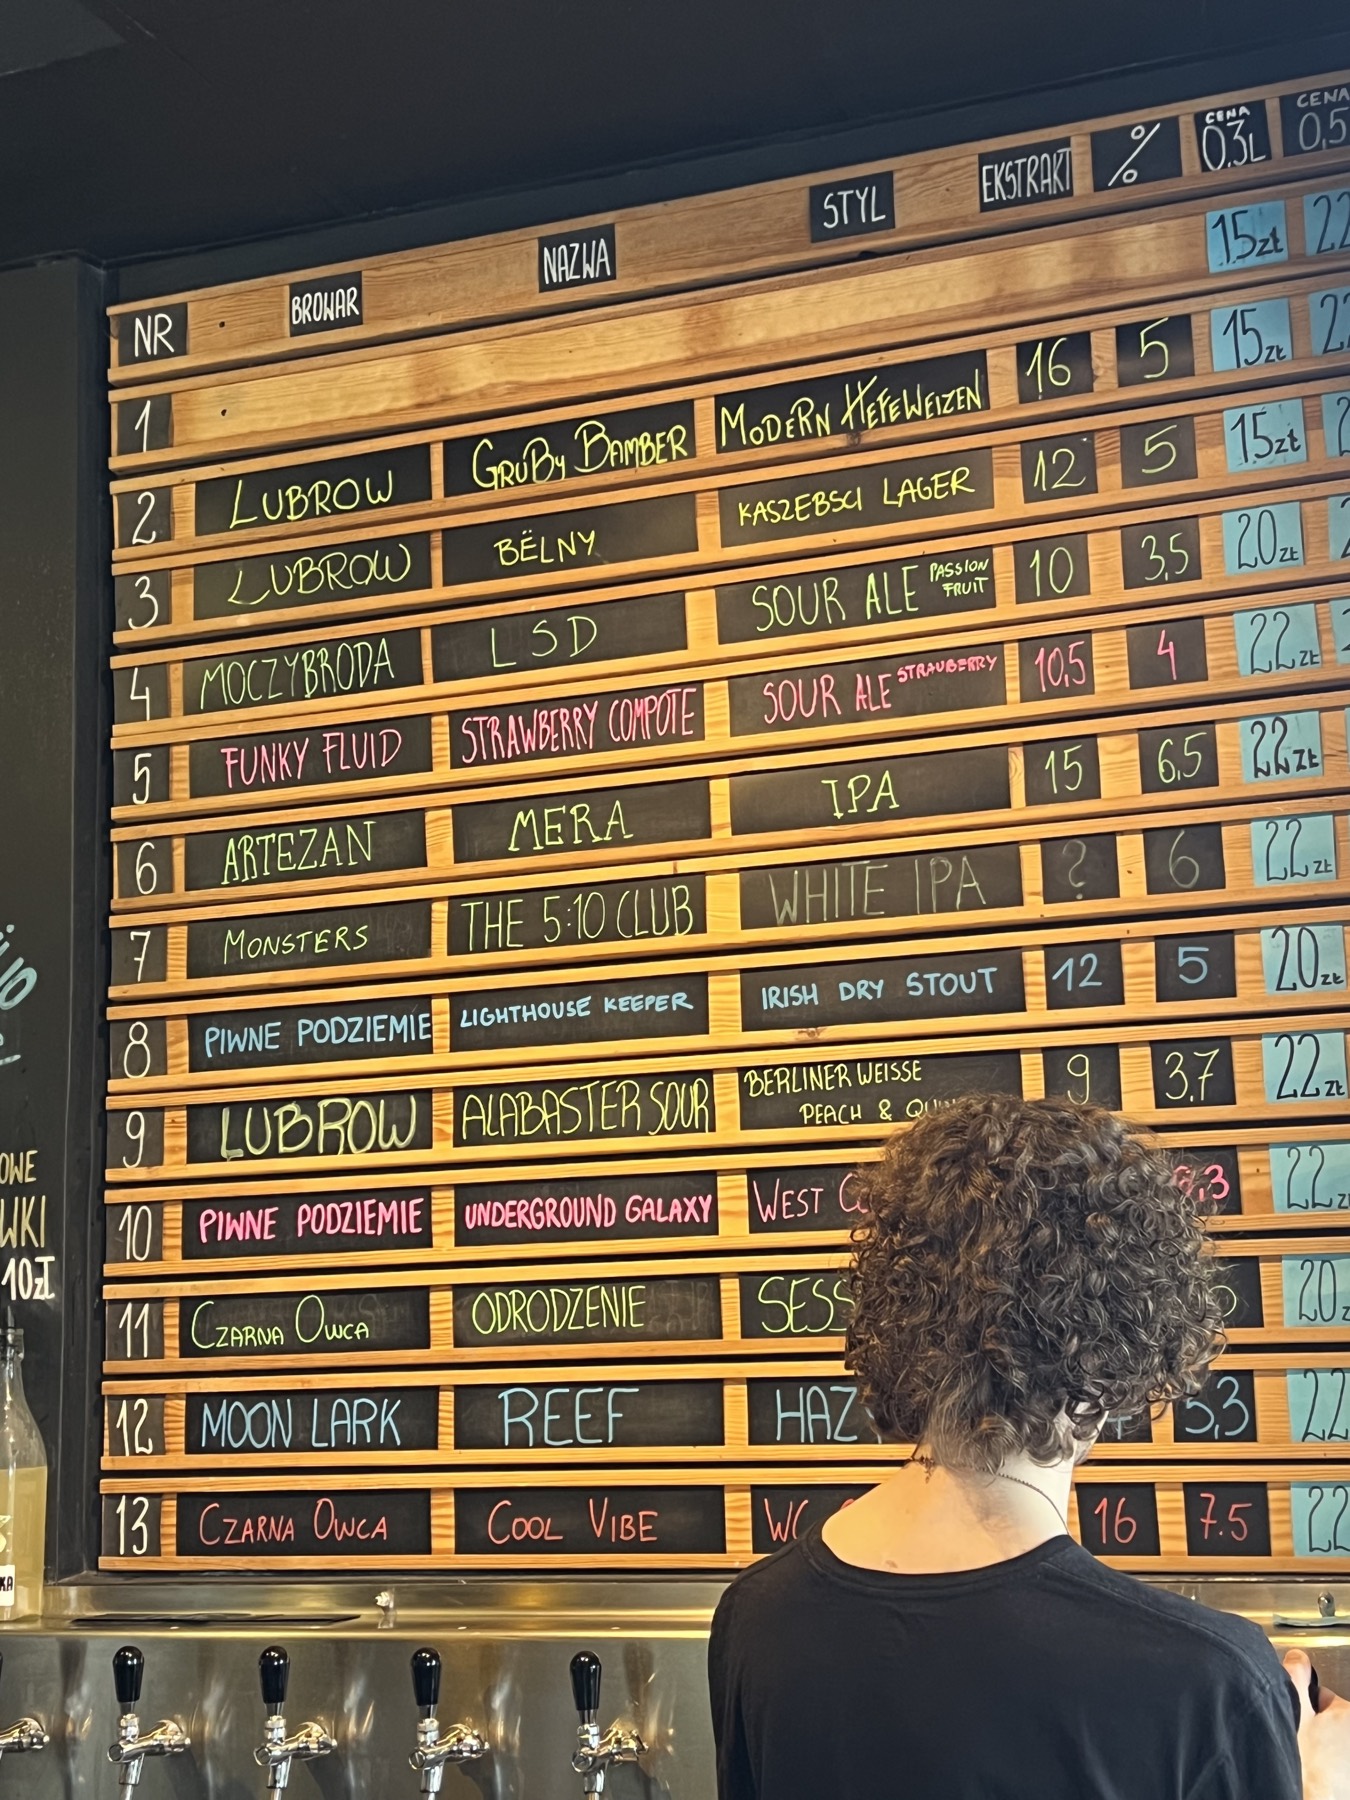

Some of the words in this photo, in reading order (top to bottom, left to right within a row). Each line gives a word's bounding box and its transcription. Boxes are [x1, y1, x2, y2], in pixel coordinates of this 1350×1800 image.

[1205, 106, 1250, 124] CENA
[1296, 87, 1350, 108] CENA
[982, 148, 1072, 203] EKSTRAKT
[1108, 122, 1161, 187] %
[823, 184, 886, 229] STYL
[543, 238, 611, 285] NAZWA
[291, 286, 359, 325] BROWAR
[134, 313, 174, 357] NR
[1140, 317, 1169, 379] 5
[1026, 337, 1071, 394] 16
[135, 400, 150, 453] 1
[574, 420, 688, 473] BAMBER
[1141, 424, 1178, 474] 5
[738, 487, 862, 526] KASZEBSCI
[883, 466, 975, 508] LAGER
[1033, 448, 1087, 492] 12
[131, 491, 156, 545] 2
[229, 470, 393, 530] LUBROW
[227, 543, 411, 605] LUBROW
[929, 558, 989, 582] PASSION
[1029, 546, 1073, 597] 10
[1141, 532, 1189, 581] 3,5
[128, 575, 159, 630] 3
[752, 576, 846, 632] SOUR
[865, 565, 919, 620] ALE
[941, 576, 989, 598] FRUIT
[200, 637, 395, 710] MOCZYBRODA
[1034, 640, 1087, 693] 10,5
[1157, 629, 1177, 681] 4
[130, 667, 150, 722] 4
[762, 674, 842, 725] SOUR
[855, 673, 892, 712] ALE
[461, 700, 598, 764] STRAWBERRY
[608, 688, 697, 742] COMPOTE
[132, 752, 152, 805] 5
[220, 737, 309, 788] FUNKY
[322, 729, 402, 774] FLUID
[1045, 745, 1082, 794] 15
[1158, 732, 1207, 784] 6,5
[821, 769, 900, 819] IPA
[508, 800, 634, 852] MERA
[135, 841, 157, 895] 6
[220, 821, 377, 885] ARTEZAN
[1062, 839, 1087, 900] ?
[1168, 829, 1200, 889] 6
[769, 860, 889, 926] WHITE
[914, 855, 987, 915] IPA
[461, 899, 524, 951] THE
[543, 891, 606, 943] 5:10
[616, 885, 693, 939] CLUB
[130, 930, 151, 982] 7
[1051, 952, 1103, 992] 12
[1177, 946, 1210, 985] 5
[460, 995, 592, 1028] LIGHTHOUSE
[604, 991, 694, 1014] KEEPER
[761, 983, 819, 1010] IRISH
[838, 979, 885, 1001] DRY
[906, 966, 998, 996] STOUT
[123, 1021, 151, 1079] 8
[204, 1021, 282, 1058] PIWNE
[298, 1013, 432, 1047] PODZIEMIE
[743, 1062, 852, 1098] BERLINER
[856, 1060, 922, 1086] WEISSE
[1066, 1053, 1090, 1105] 9
[220, 1095, 417, 1161] LUBROW
[461, 1079, 642, 1140] ALABASTER
[647, 1077, 710, 1136] SOUR
[799, 1103, 862, 1125] PEACH
[878, 1098, 893, 1121] &
[122, 1110, 145, 1169] 9
[198, 1206, 279, 1244] PIWNE
[297, 1197, 425, 1238] PODZIEMIE
[464, 1193, 617, 1230] UNDERGROUND
[624, 1194, 713, 1224] GALAXY
[753, 1178, 824, 1223] WEST
[118, 1204, 152, 1262] 10
[118, 1302, 150, 1359] 11
[471, 1285, 646, 1335] ODRODZENIE
[116, 1398, 153, 1457] 12
[201, 1398, 292, 1449] MOON
[311, 1398, 401, 1448] LARK
[498, 1387, 639, 1447] REEF
[1302, 1368, 1349, 1442] 22
[116, 1495, 149, 1556] 13
[487, 1500, 564, 1544] COOL
[589, 1497, 659, 1543] VIBE
[1094, 1497, 1137, 1544] 16
[1199, 1493, 1252, 1541] 7.5
[1309, 1485, 1350, 1552] 22
